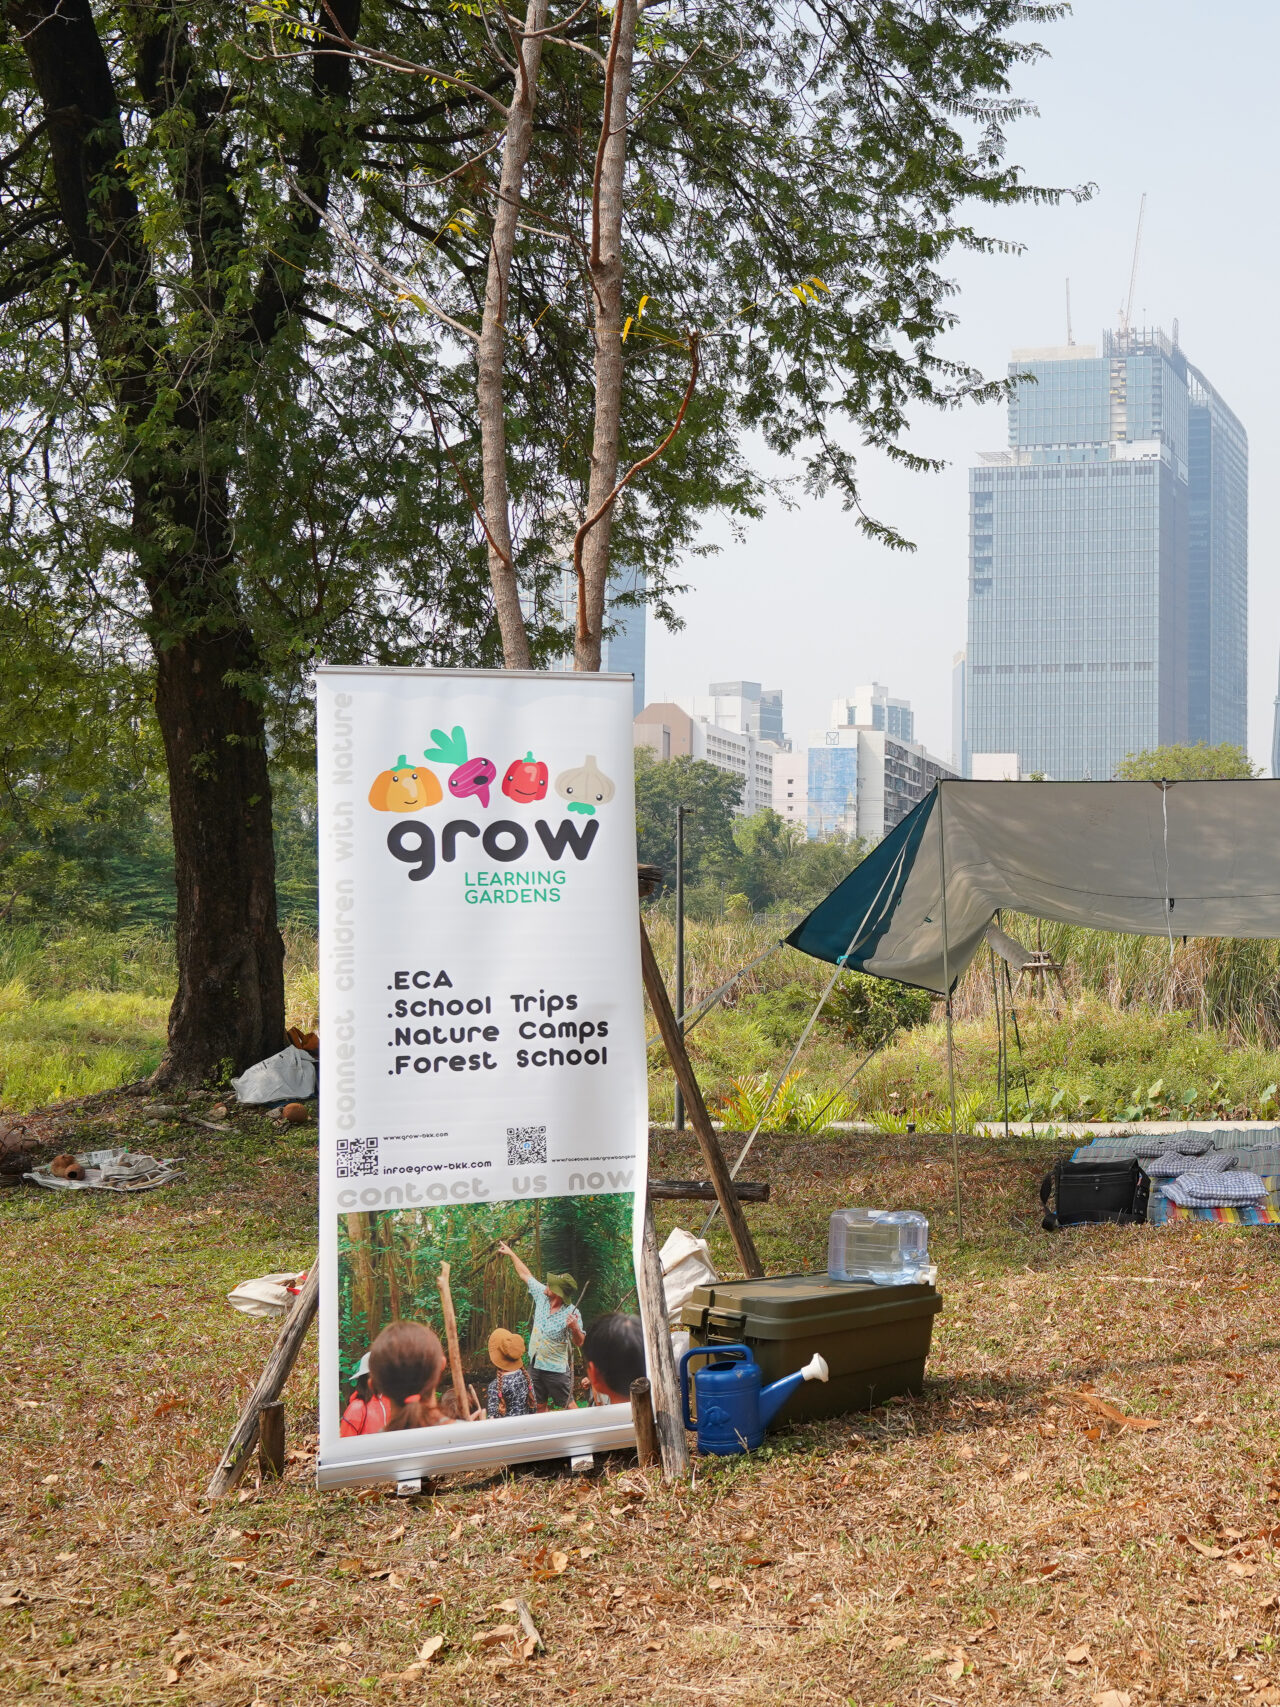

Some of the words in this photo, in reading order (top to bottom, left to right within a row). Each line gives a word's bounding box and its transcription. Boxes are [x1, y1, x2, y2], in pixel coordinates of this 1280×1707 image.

[332, 692, 353, 785] Nature
[328, 801, 354, 862] with
[386, 818, 600, 882] grow
[464, 870, 566, 887] LEARNING
[464, 888, 561, 904] GARDENS
[329, 879, 355, 992] children
[387, 969, 453, 990] .ECA
[387, 996, 491, 1018] .School
[510, 989, 578, 1017] Trips
[387, 1025, 500, 1046] .Nature
[518, 1020, 609, 1044] Camps
[336, 1009, 356, 1131] connect
[387, 1051, 497, 1075] .Forest
[516, 1046, 607, 1068] School
[383, 1132, 449, 1141] www.grow-bkk.com
[383, 1161, 492, 1175] info@grow-bkk.com
[337, 1177, 490, 1208] contact
[512, 1174, 547, 1194] us
[568, 1169, 634, 1190] now
